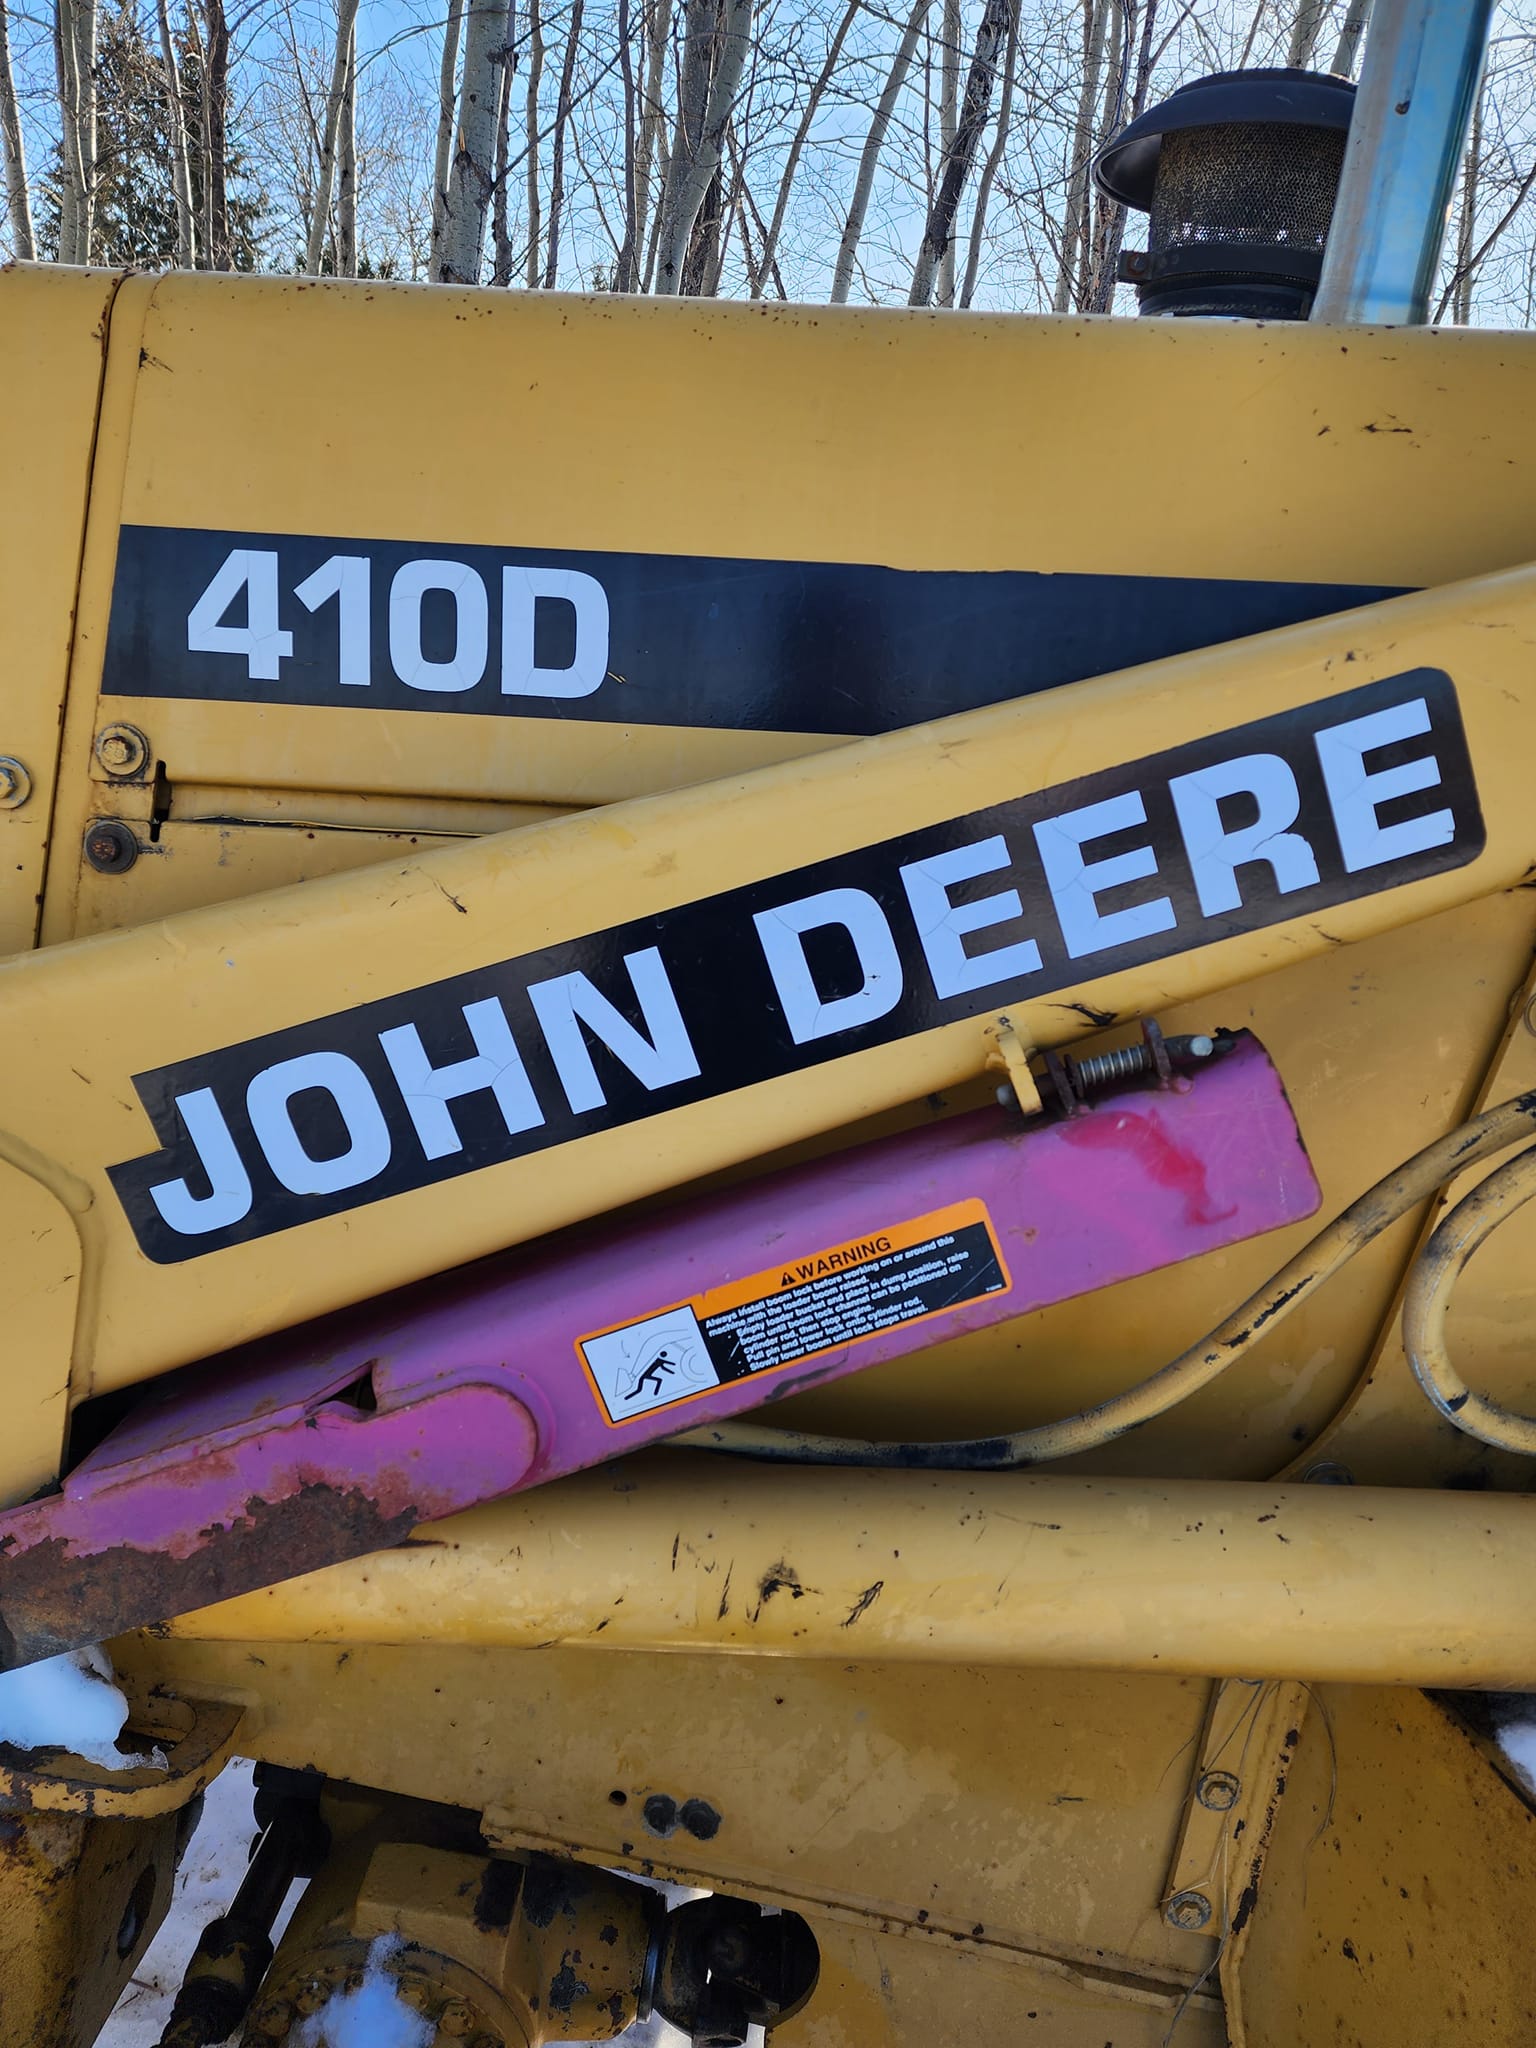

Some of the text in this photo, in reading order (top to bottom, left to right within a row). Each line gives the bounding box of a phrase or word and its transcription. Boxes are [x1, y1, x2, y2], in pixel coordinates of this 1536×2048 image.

[187, 549, 610, 699] 410D
[149, 697, 1455, 1236] JOHN DEERE
[706, 1313, 737, 1328] Always
[766, 1293, 792, 1306] boom
[793, 1285, 813, 1297] lock
[813, 1276, 842, 1290] before
[843, 1263, 879, 1279] working
[880, 1258, 892, 1267] on
[893, 1254, 903, 1262] or
[905, 1241, 936, 1258] around
[937, 1236, 954, 1247] this
[766, 1312, 793, 1326] loader
[795, 1300, 826, 1316] bucket
[827, 1293, 844, 1305] and
[845, 1286, 869, 1300] place
[881, 1273, 906, 1287] dump
[947, 1252, 969, 1263] raise
[796, 1237, 891, 1279] WARNING
[709, 1275, 869, 1336] machine with the loader boom raised.
[740, 1264, 961, 1345] boom until boom lock channel can be positioned on
[744, 1337, 778, 1354] cylinder
[799, 1323, 819, 1334] then
[821, 1316, 841, 1327] stop
[746, 1297, 922, 1362] Pull pin and lower lock onto cylinder rod.
[750, 1304, 928, 1371] Slowly lower boom until lock stops travel.
